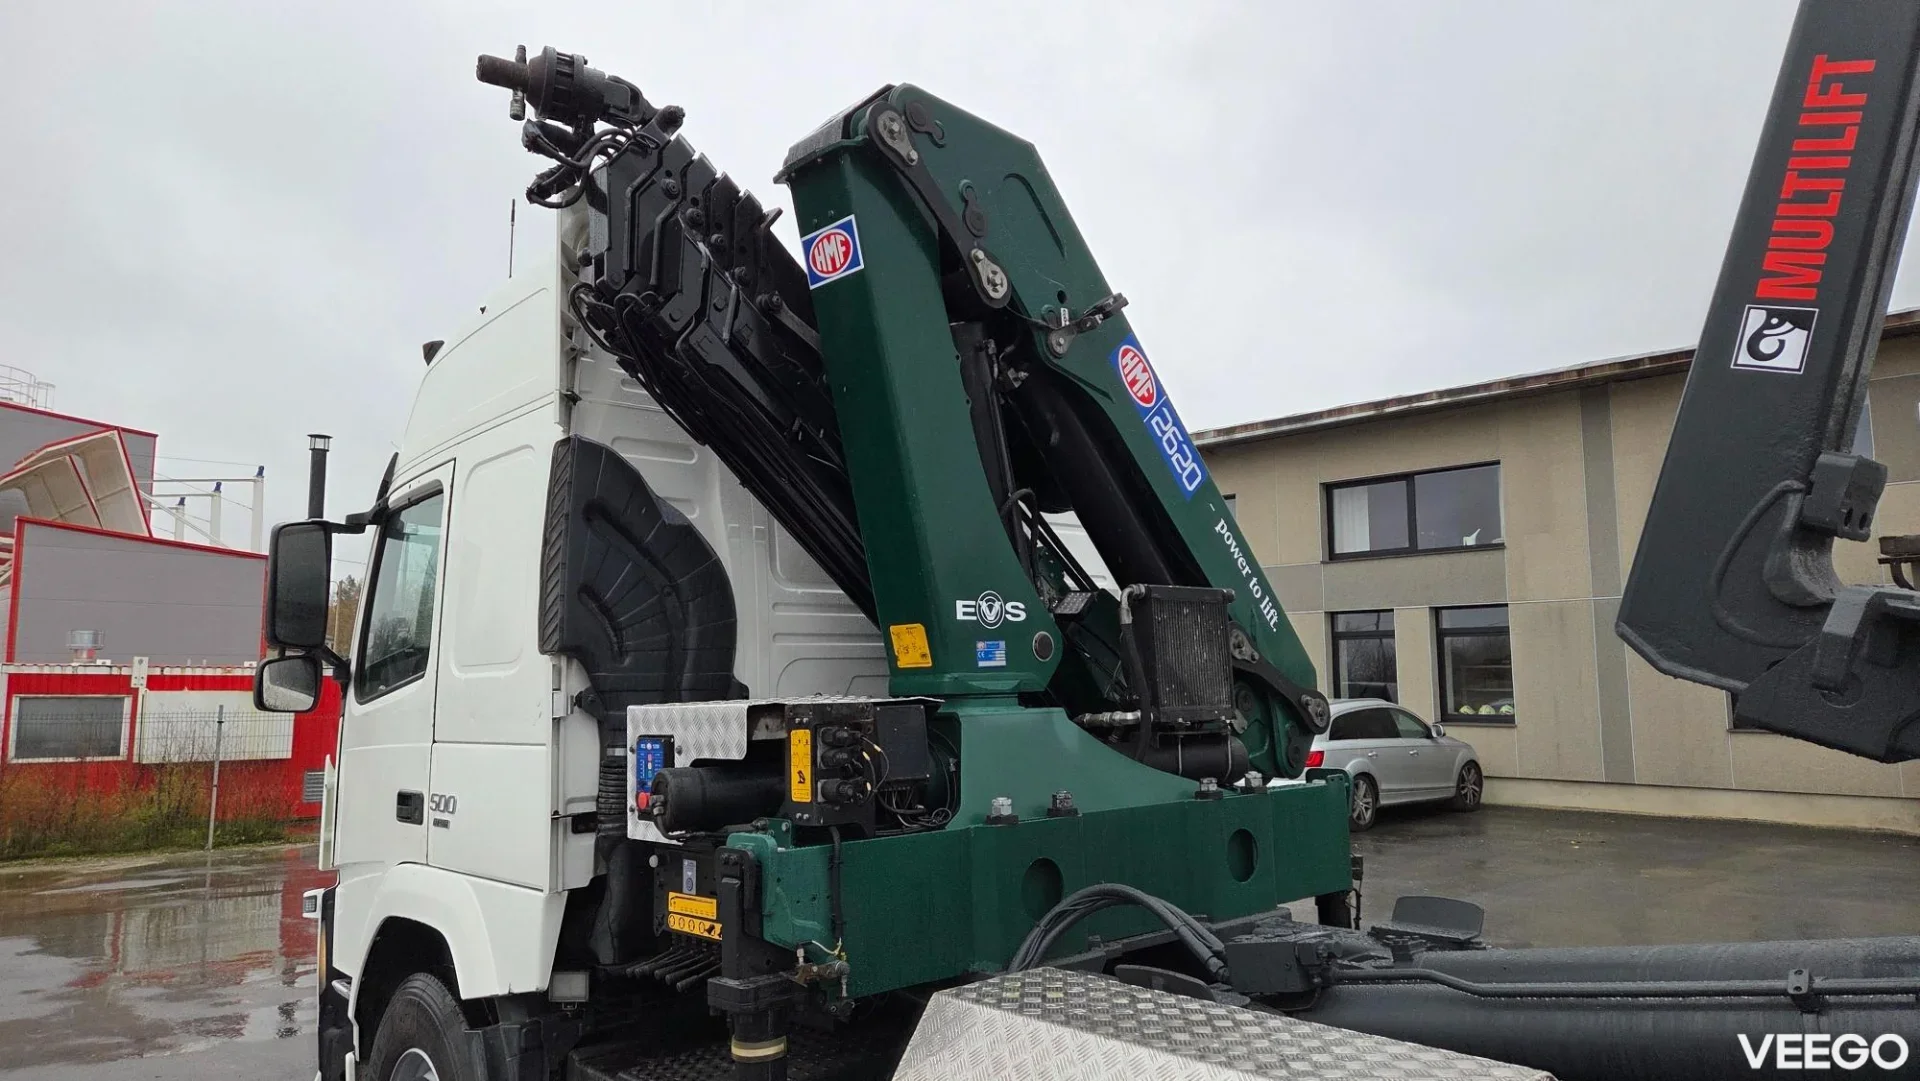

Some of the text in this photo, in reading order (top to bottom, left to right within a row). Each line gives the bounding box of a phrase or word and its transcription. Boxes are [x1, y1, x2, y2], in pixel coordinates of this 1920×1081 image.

[1755, 54, 1876, 300] MULTILIFT
[813, 234, 846, 272] HMF
[1121, 350, 1202, 492] HMF 2620
[1214, 517, 1252, 577] power
[1249, 576, 1262, 599] to
[1259, 595, 1279, 632] lift.
[430, 793, 457, 815] 500
